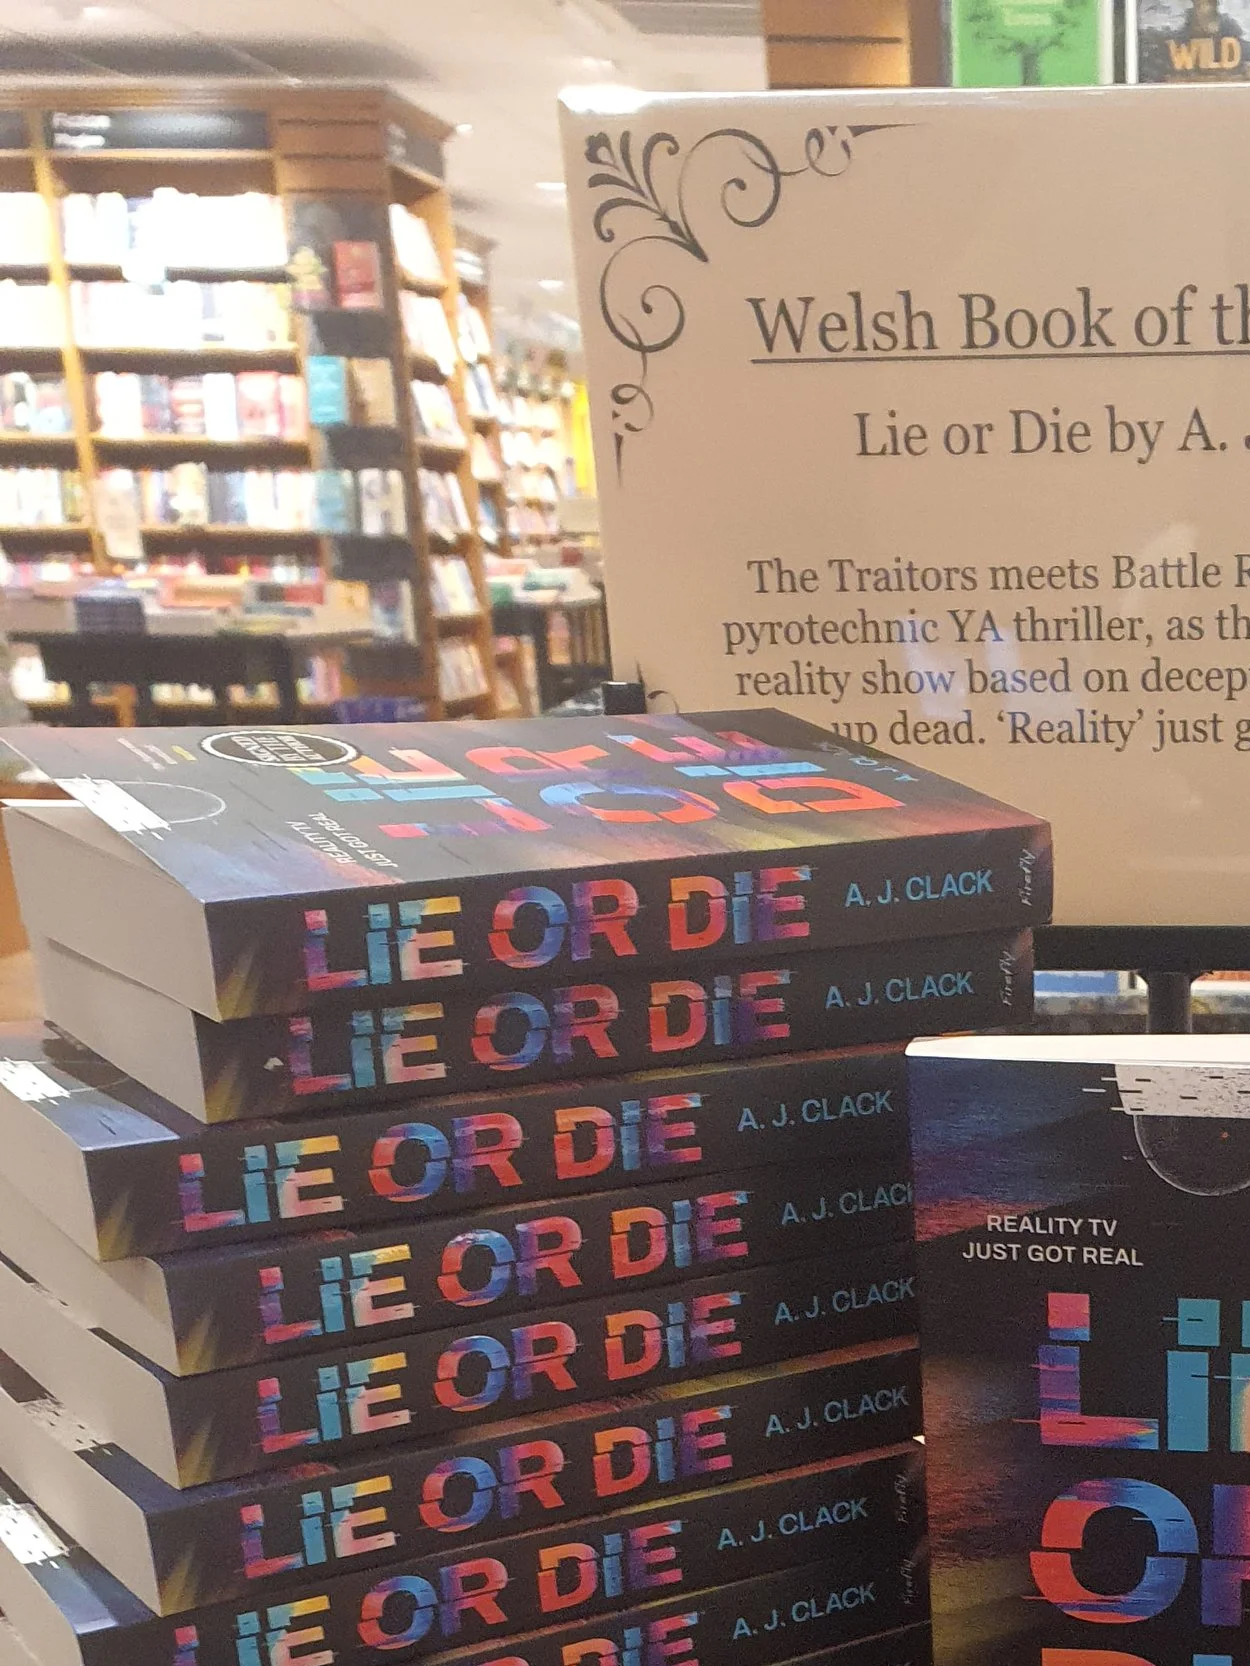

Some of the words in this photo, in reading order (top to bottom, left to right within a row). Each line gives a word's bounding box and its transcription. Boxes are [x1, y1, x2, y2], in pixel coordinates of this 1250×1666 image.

[746, 290, 940, 353] Welsh
[958, 287, 1116, 350] Book
[1134, 284, 1197, 347] of
[854, 409, 929, 456] Lie
[943, 423, 994, 455] or
[1009, 407, 1092, 454] Die
[1105, 404, 1165, 465] by
[1177, 407, 1227, 451] A.
[747, 557, 819, 593] The
[828, 557, 978, 592] Traitors
[989, 562, 1100, 590] meets
[1111, 554, 1221, 589] Battle
[723, 607, 940, 656] pyrotechnic
[947, 609, 1004, 643] YA
[1013, 606, 1153, 647] thriller,
[1166, 613, 1205, 641] as
[736, 660, 850, 704] reality
[861, 658, 956, 695] show
[965, 657, 1071, 694] based
[1083, 667, 1129, 693] on
[889, 710, 985, 745] dead.
[1152, 709, 1224, 752] just
[487, 878, 641, 968] OR
[845, 883, 867, 908] A.
[876, 881, 899, 904] J.
[905, 869, 994, 902] CLACK
[368, 1112, 525, 1202] OR
[738, 1108, 764, 1131] A.
[772, 1105, 796, 1127] J.
[802, 1090, 893, 1123] CLACK
[987, 1214, 1084, 1237] REALITY
[1087, 1218, 1118, 1238] TV
[962, 1242, 1021, 1263] JUST
[1027, 1244, 1078, 1264] GOT
[1083, 1246, 1144, 1267] REAL
[732, 1617, 757, 1641] A.
[764, 1609, 785, 1630] J.
[791, 1582, 876, 1621] CLACK
